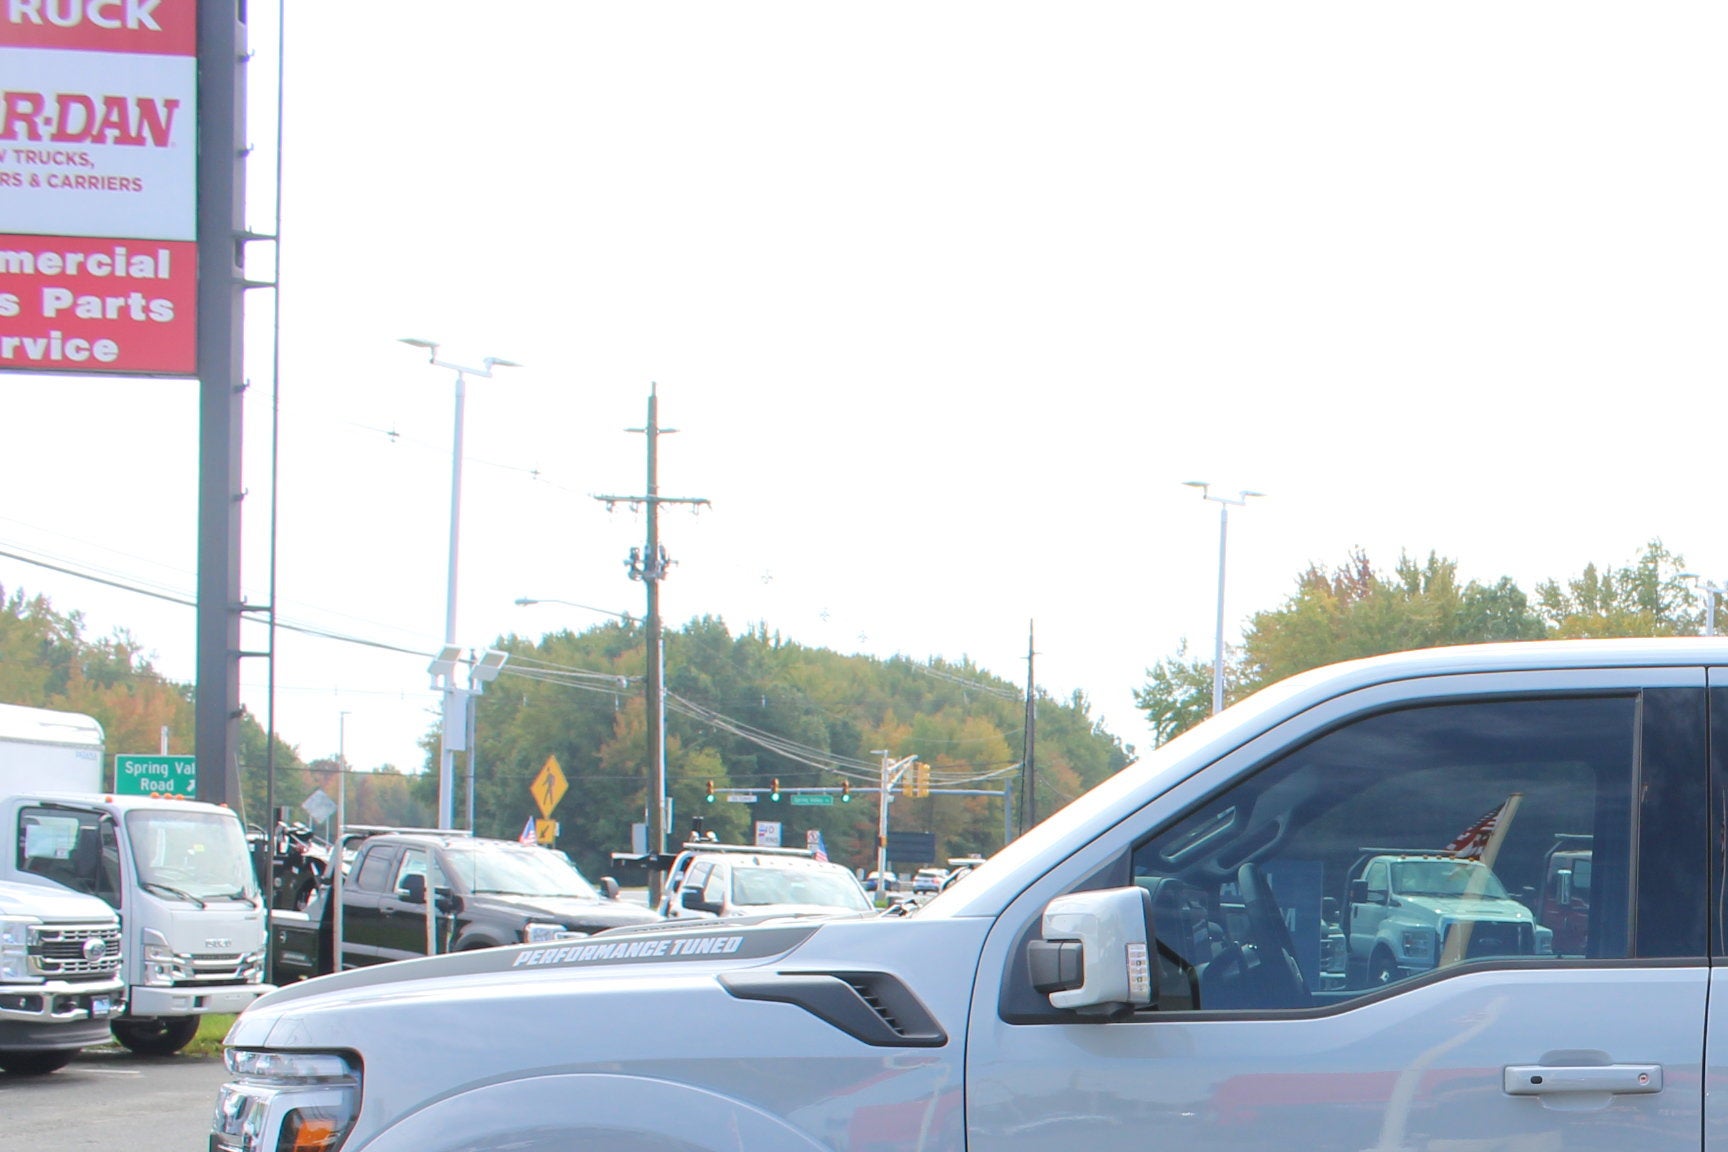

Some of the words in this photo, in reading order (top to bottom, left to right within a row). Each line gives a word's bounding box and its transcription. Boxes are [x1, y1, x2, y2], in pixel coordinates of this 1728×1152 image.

[14, 150, 95, 169] TRUCKS,
[29, 173, 41, 188] &
[47, 174, 143, 192] CARRIERS
[0, 246, 170, 279] mercial
[42, 287, 175, 322] Parts
[1, 330, 119, 362] rvice
[125, 761, 169, 778] Spring
[140, 778, 174, 792] Road
[512, 940, 673, 967] PERFORMANCE
[670, 936, 744, 956] TUNED
